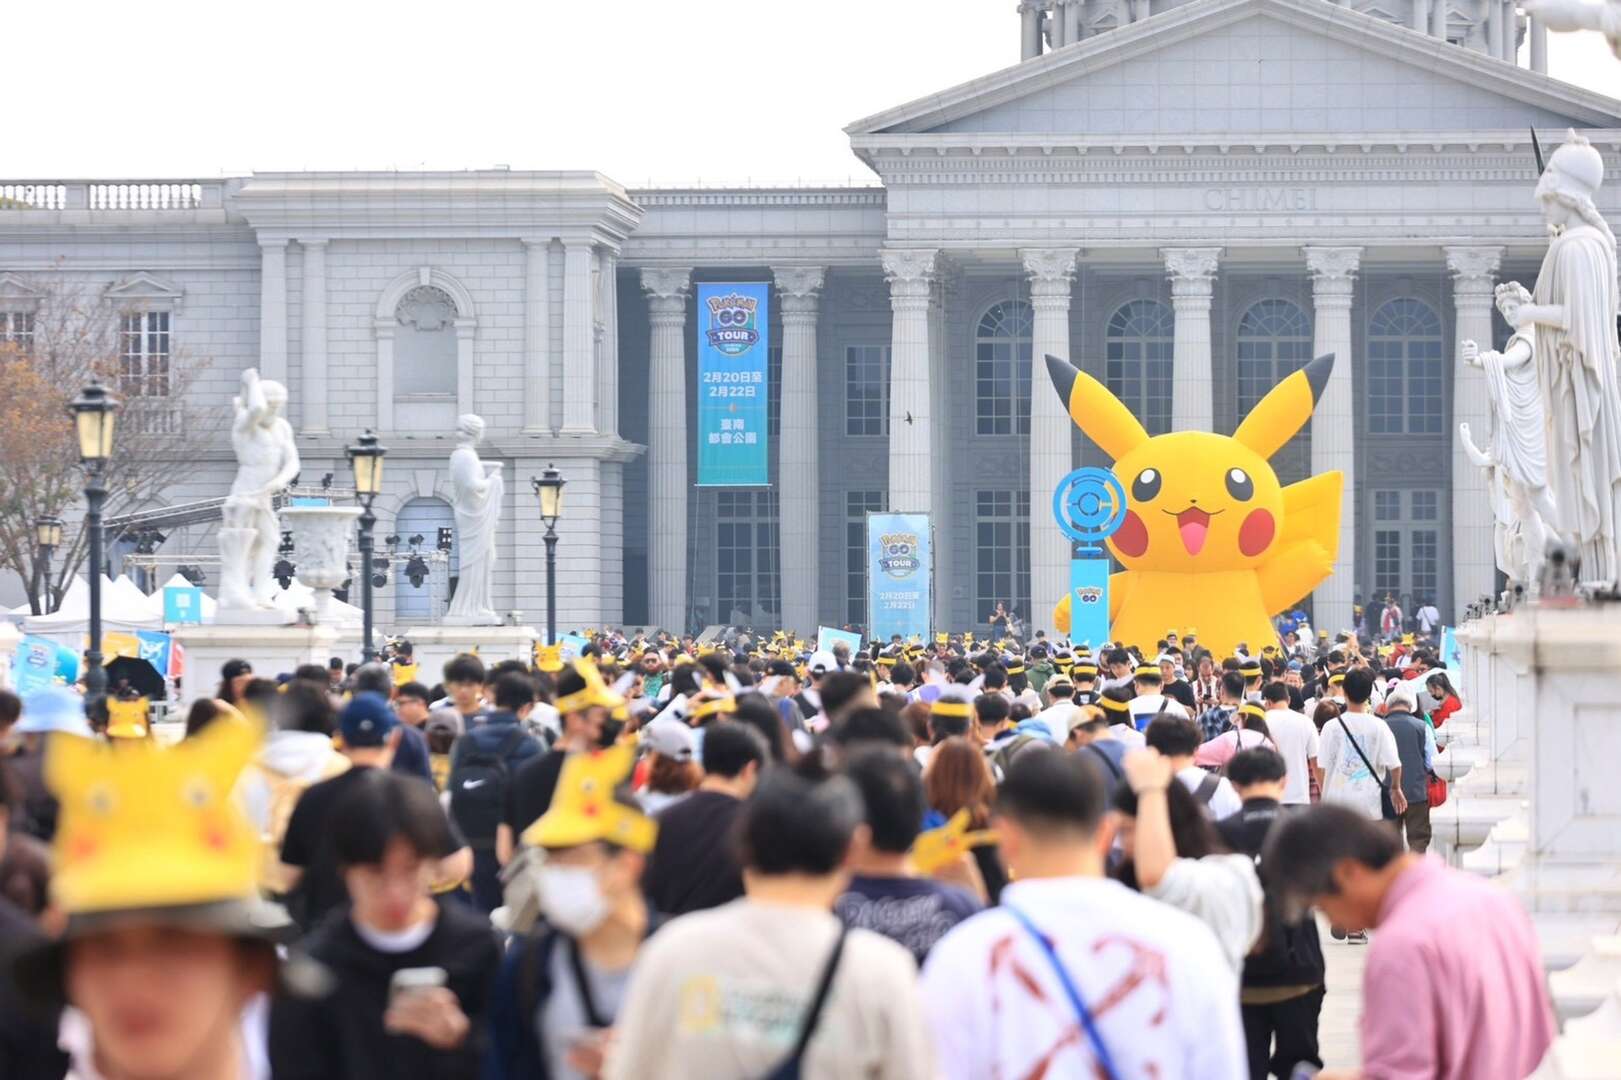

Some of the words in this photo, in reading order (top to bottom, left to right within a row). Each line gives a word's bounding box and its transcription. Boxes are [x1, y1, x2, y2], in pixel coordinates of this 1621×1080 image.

[1206, 188, 1318, 212] CHIMEI
[719, 310, 747, 325] GO
[717, 331, 749, 341] TOUR
[709, 385, 756, 398] 2月22日
[889, 545, 909, 554] GO
[887, 559, 912, 568] TOUR
